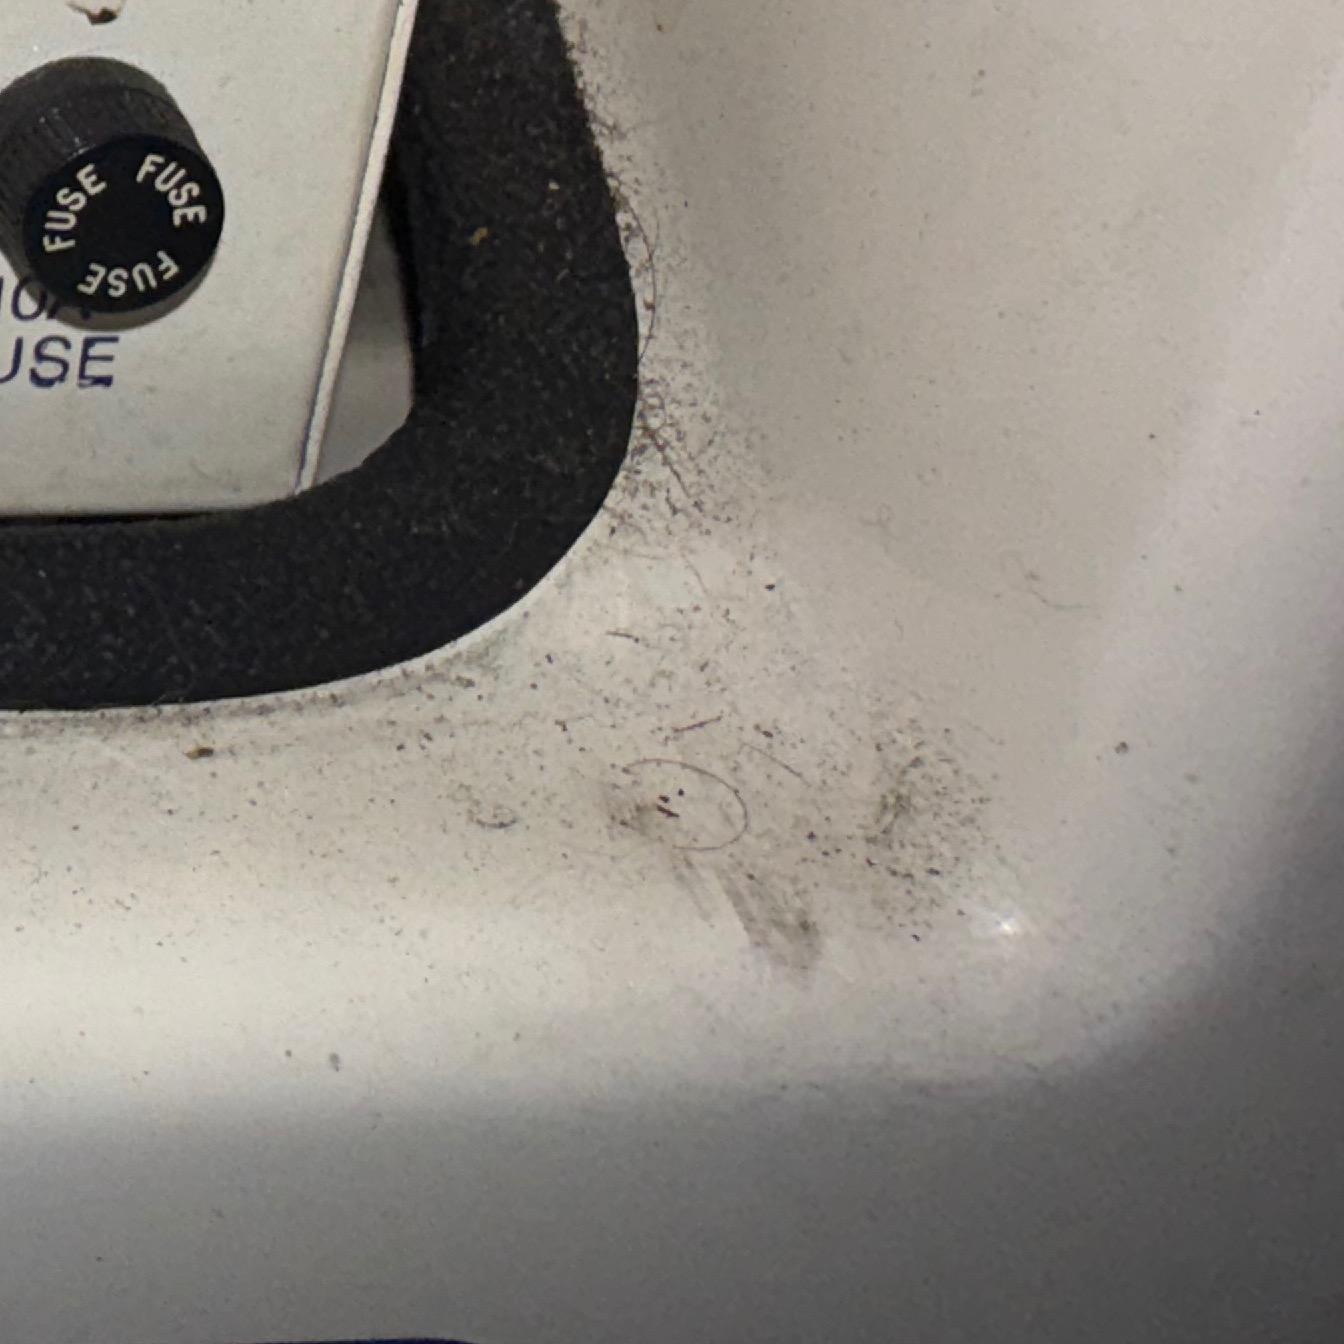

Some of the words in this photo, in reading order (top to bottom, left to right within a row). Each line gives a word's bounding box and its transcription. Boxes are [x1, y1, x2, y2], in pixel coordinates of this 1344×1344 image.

[43, 162, 109, 254] FUSE
[135, 153, 208, 228] FUSE
[76, 249, 181, 298] FUSE
